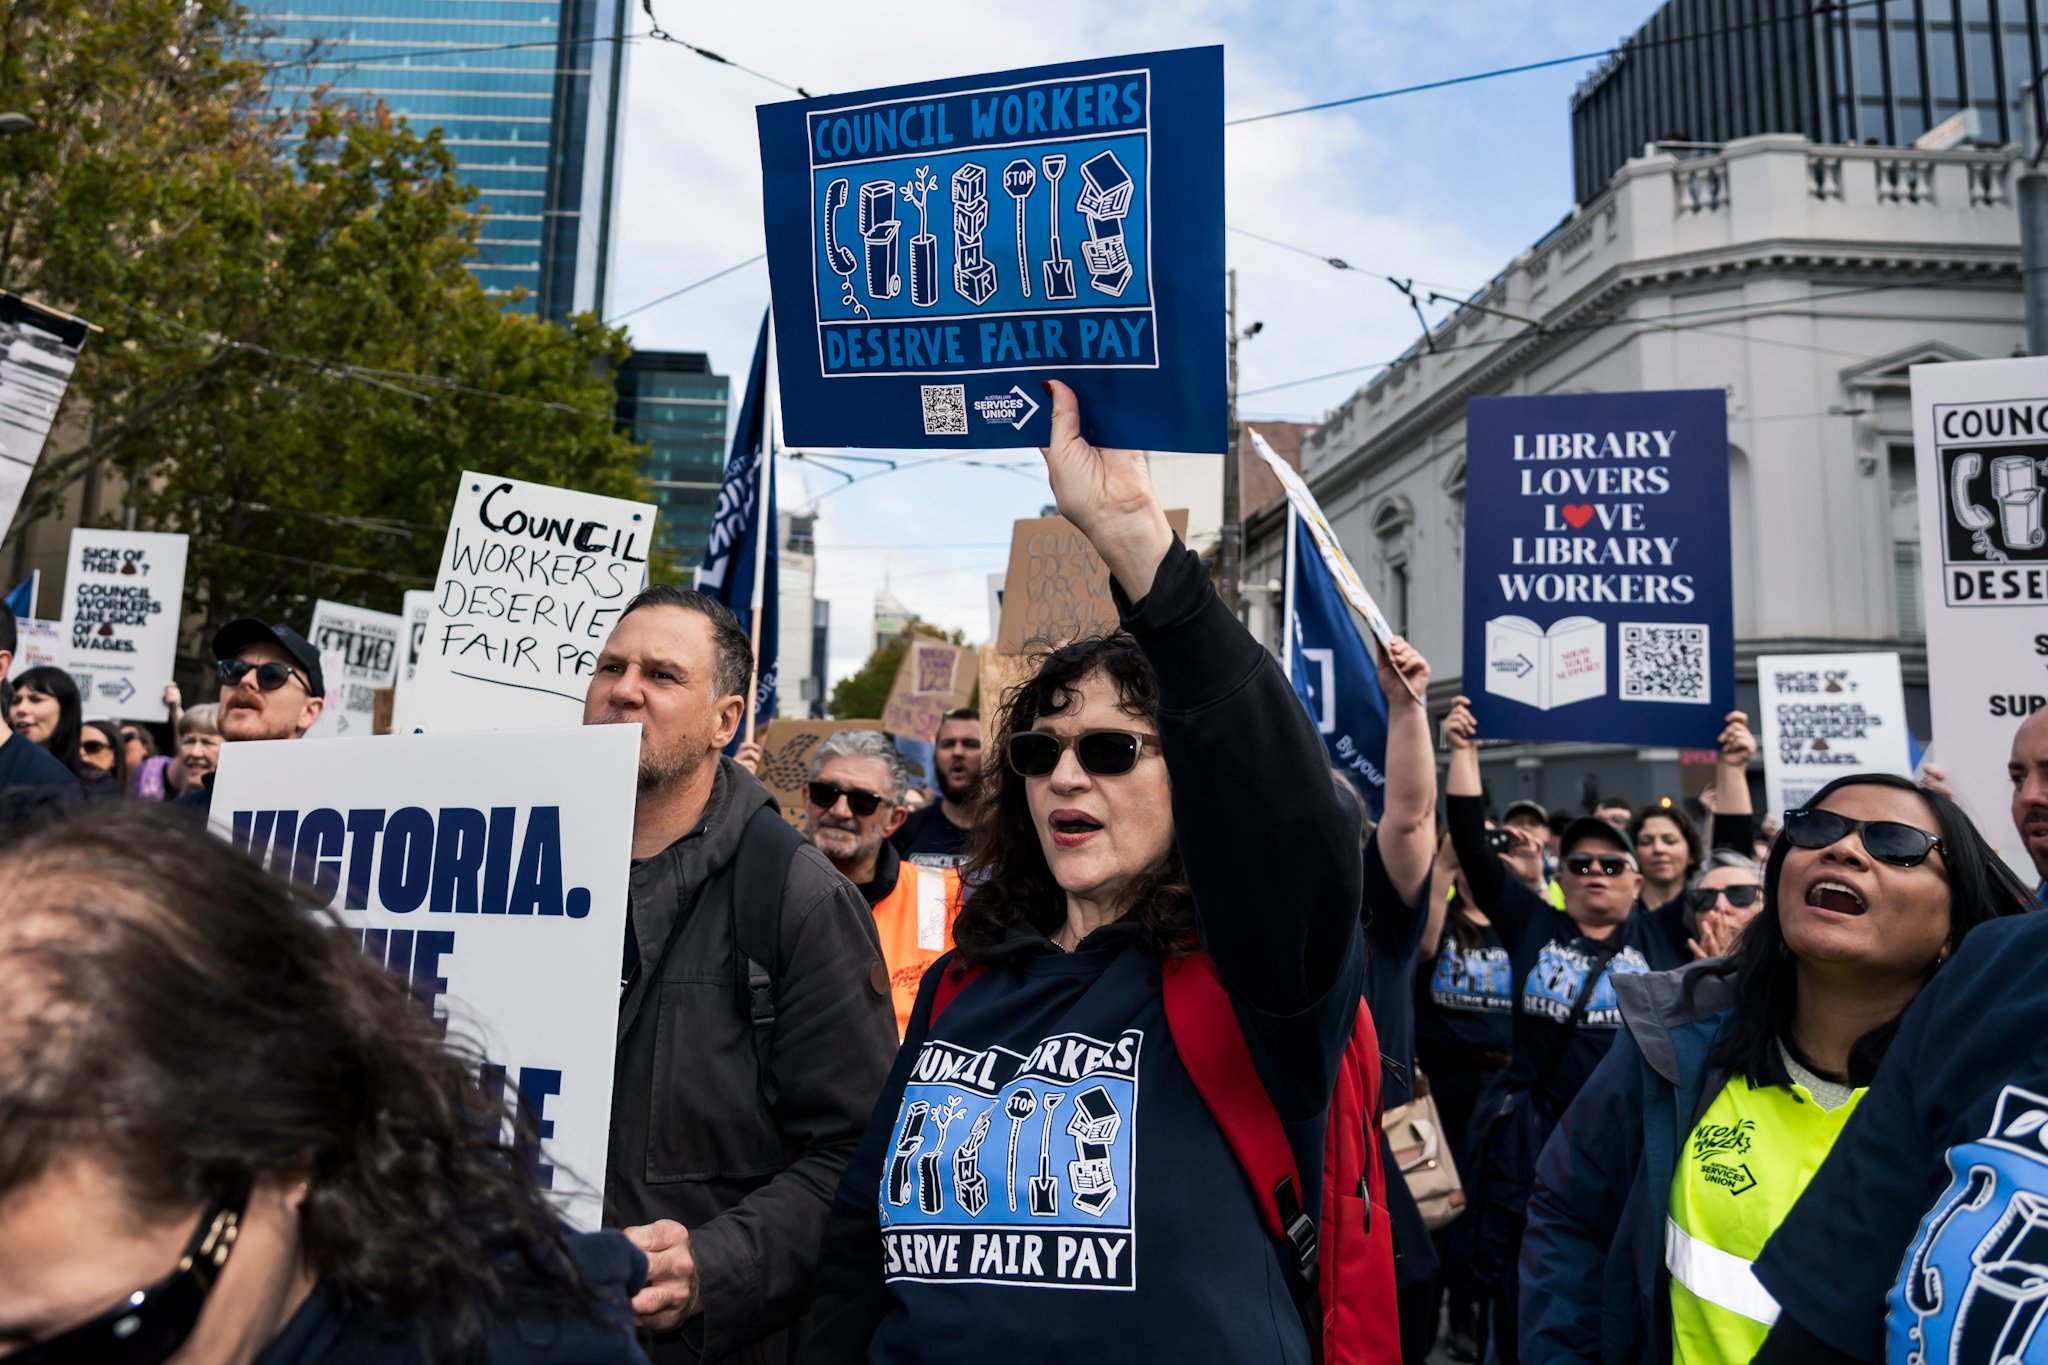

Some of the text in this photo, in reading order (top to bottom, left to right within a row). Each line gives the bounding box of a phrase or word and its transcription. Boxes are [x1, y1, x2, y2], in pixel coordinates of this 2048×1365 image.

[815, 82, 1142, 158] COUNCIL WORKERS
[1005, 169, 1033, 187] STOP
[827, 317, 1147, 369] DESERVE FAIR PAY
[974, 399, 1024, 410] SERVICES
[982, 409, 1016, 419] UNION
[1513, 430, 1676, 461] LIBRARY
[1520, 466, 1670, 496] LOVERS
[479, 483, 646, 563] COUNCIL
[83, 547, 145, 561] SICK OF
[1512, 537, 1679, 566] LIBRARY
[82, 560, 117, 574] THIS
[452, 527, 628, 599] WORKERS
[78, 584, 151, 599] COUNCIL
[1498, 573, 1696, 604] WORKERS
[77, 596, 162, 613] WORKERS
[438, 580, 621, 638] DESERVE
[75, 610, 147, 626] ARE SICK
[73, 623, 93, 635] OF
[440, 624, 540, 673] FAIR
[1775, 671, 1819, 682] SICK
[1777, 704, 1866, 714] COUNCIL
[1778, 714, 1882, 727] WORKERS
[1335, 734, 1359, 759] By
[1008, 1094, 1034, 1112] STOP
[1701, 1165, 1746, 1182] SERVICES
[1704, 1174, 1736, 1188] UNION
[883, 1233, 1127, 1279] SERVE FAIR PAY
